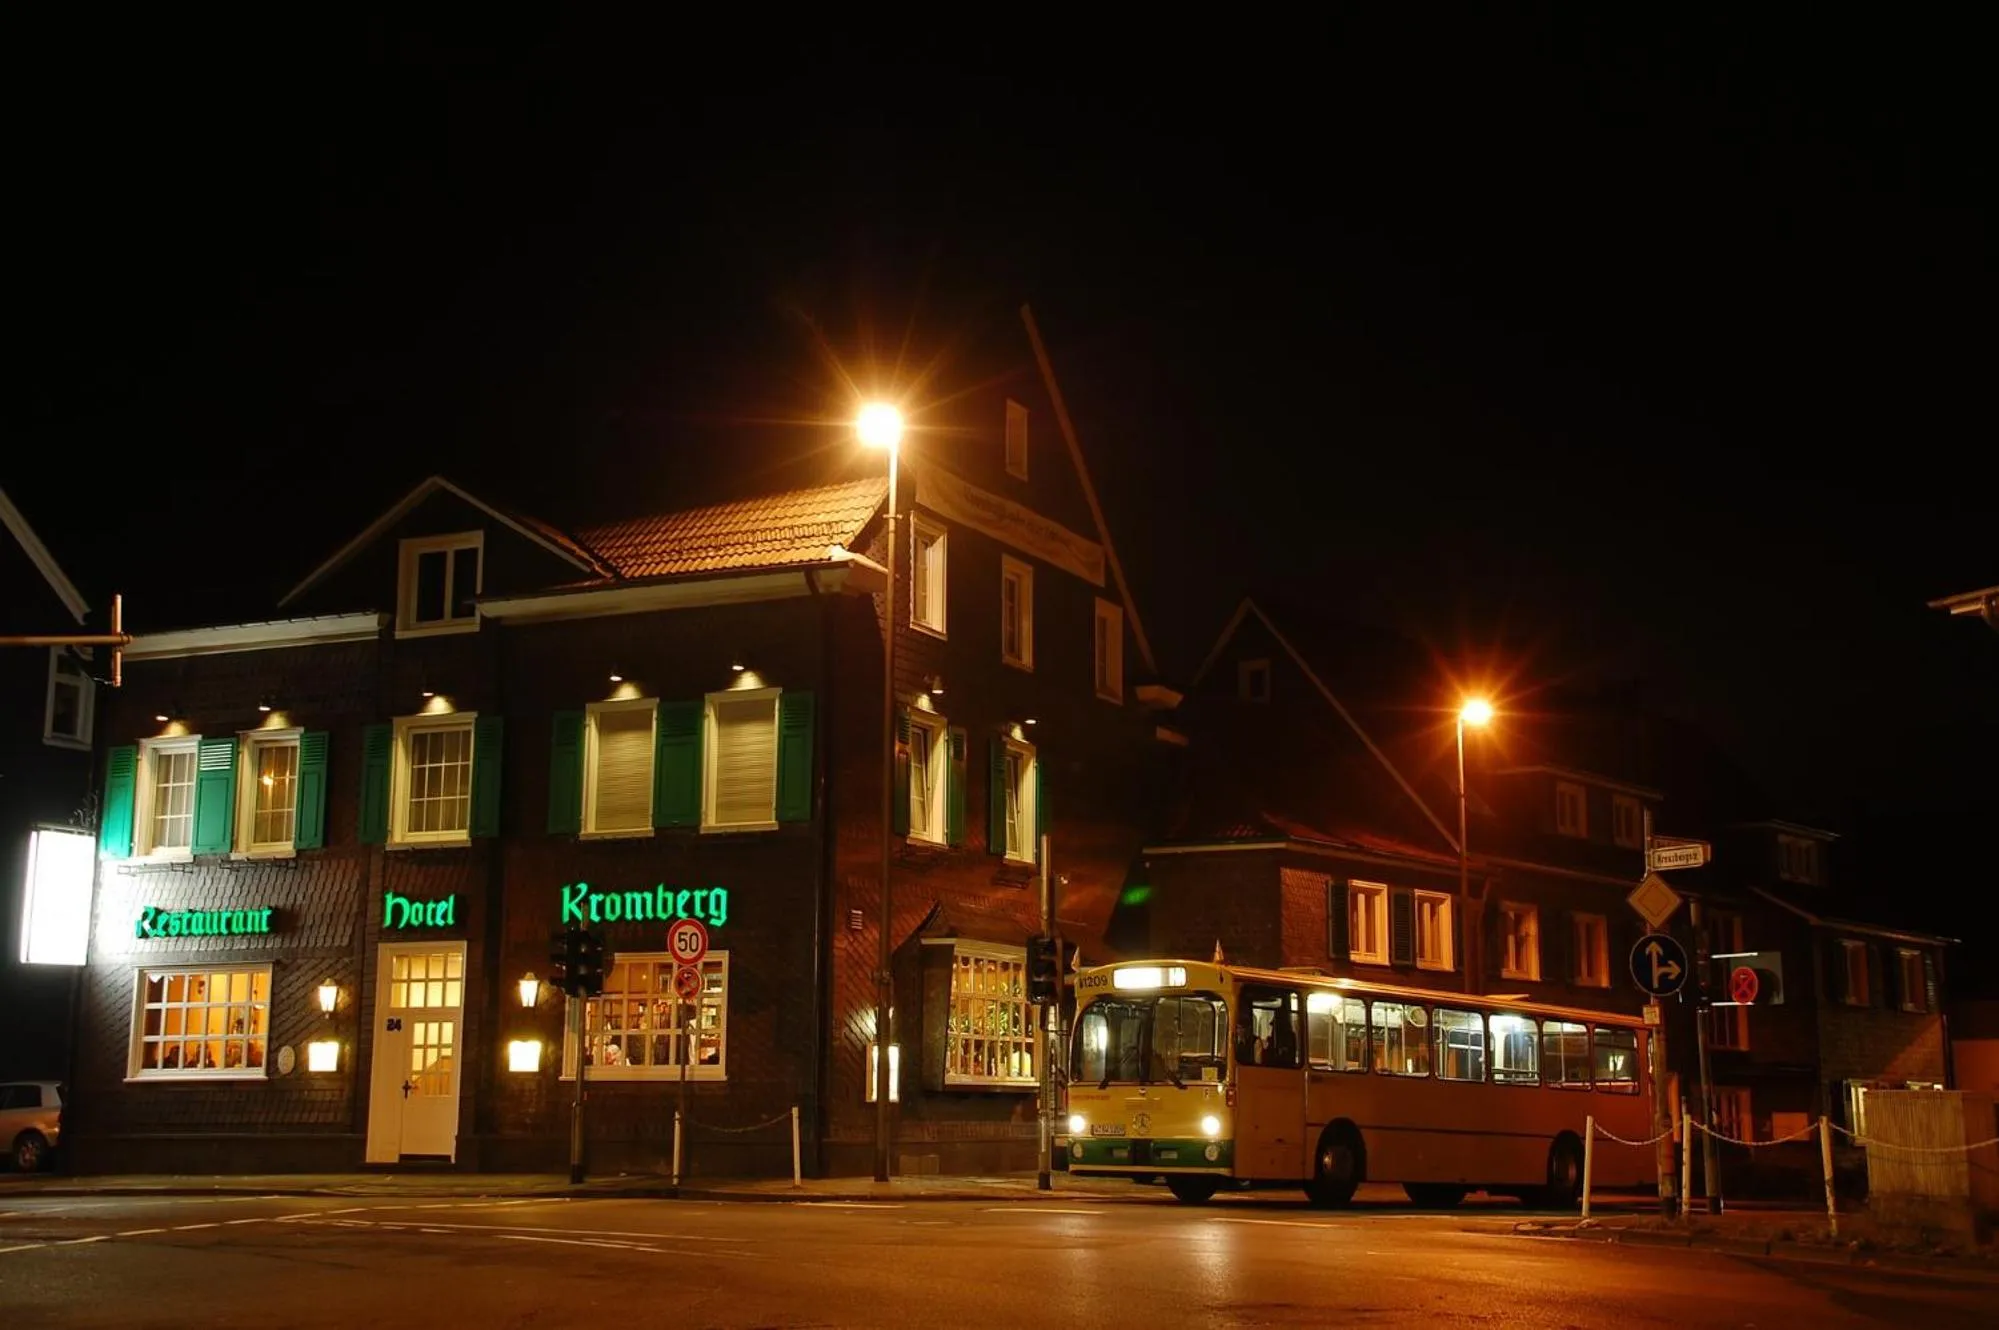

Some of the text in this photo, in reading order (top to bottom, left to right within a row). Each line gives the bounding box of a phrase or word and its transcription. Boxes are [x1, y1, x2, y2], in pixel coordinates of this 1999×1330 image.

[135, 905, 272, 937] Restaurant
[383, 891, 455, 930] Hotel
[561, 882, 728, 927] Kromberg
[678, 931, 699, 953] 50
